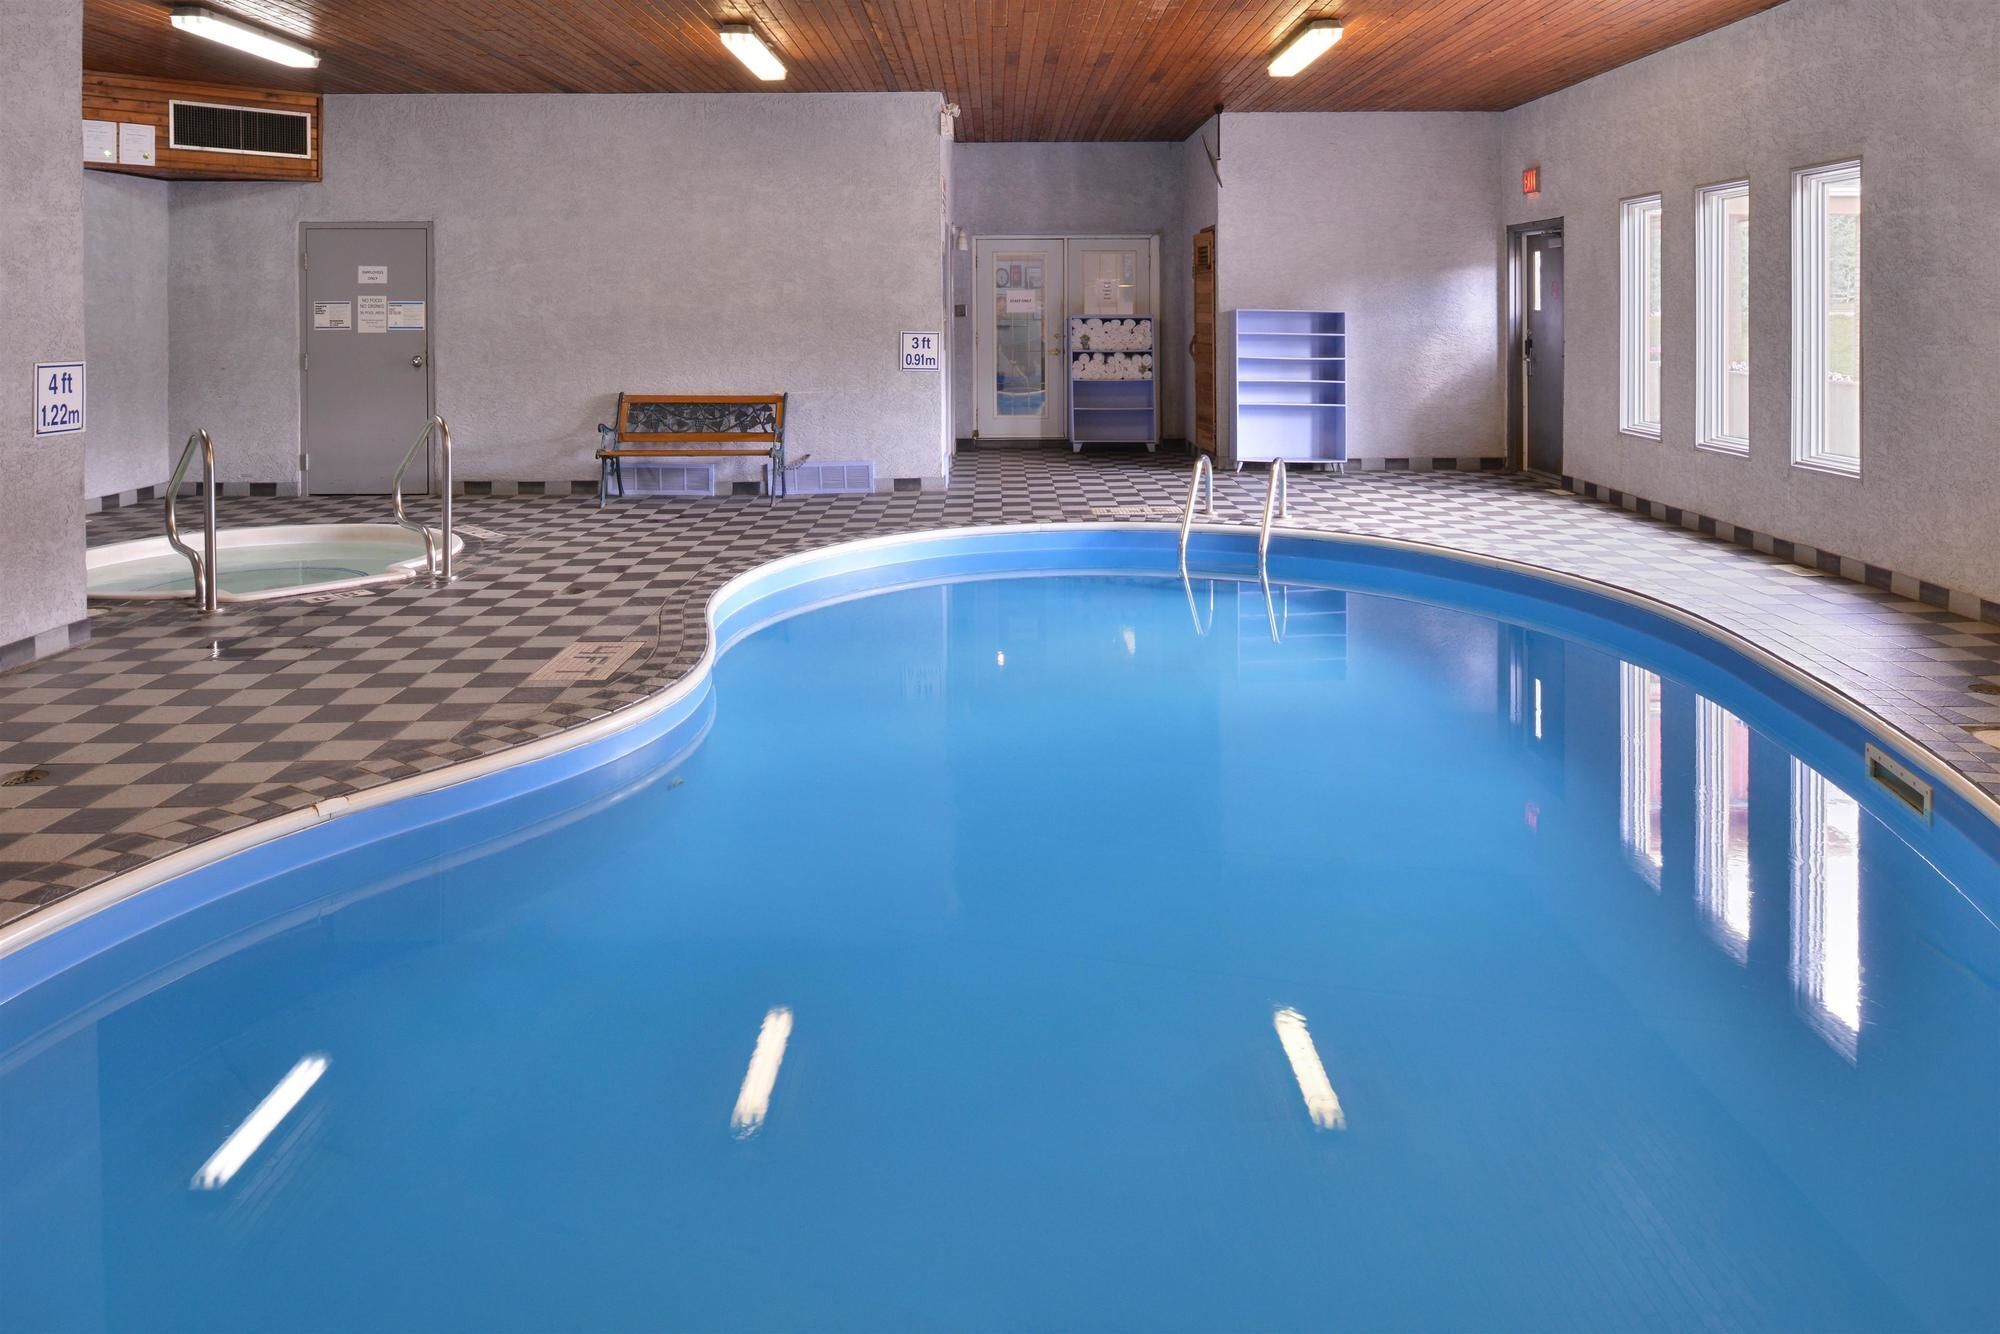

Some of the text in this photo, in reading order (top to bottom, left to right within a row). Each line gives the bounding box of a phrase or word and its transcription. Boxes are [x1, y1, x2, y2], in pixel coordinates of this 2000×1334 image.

[911, 336, 931, 349] 3 ft
[905, 353, 936, 366] 0.91m
[48, 372, 73, 395] 4 ft
[41, 403, 80, 427] 1.22m
